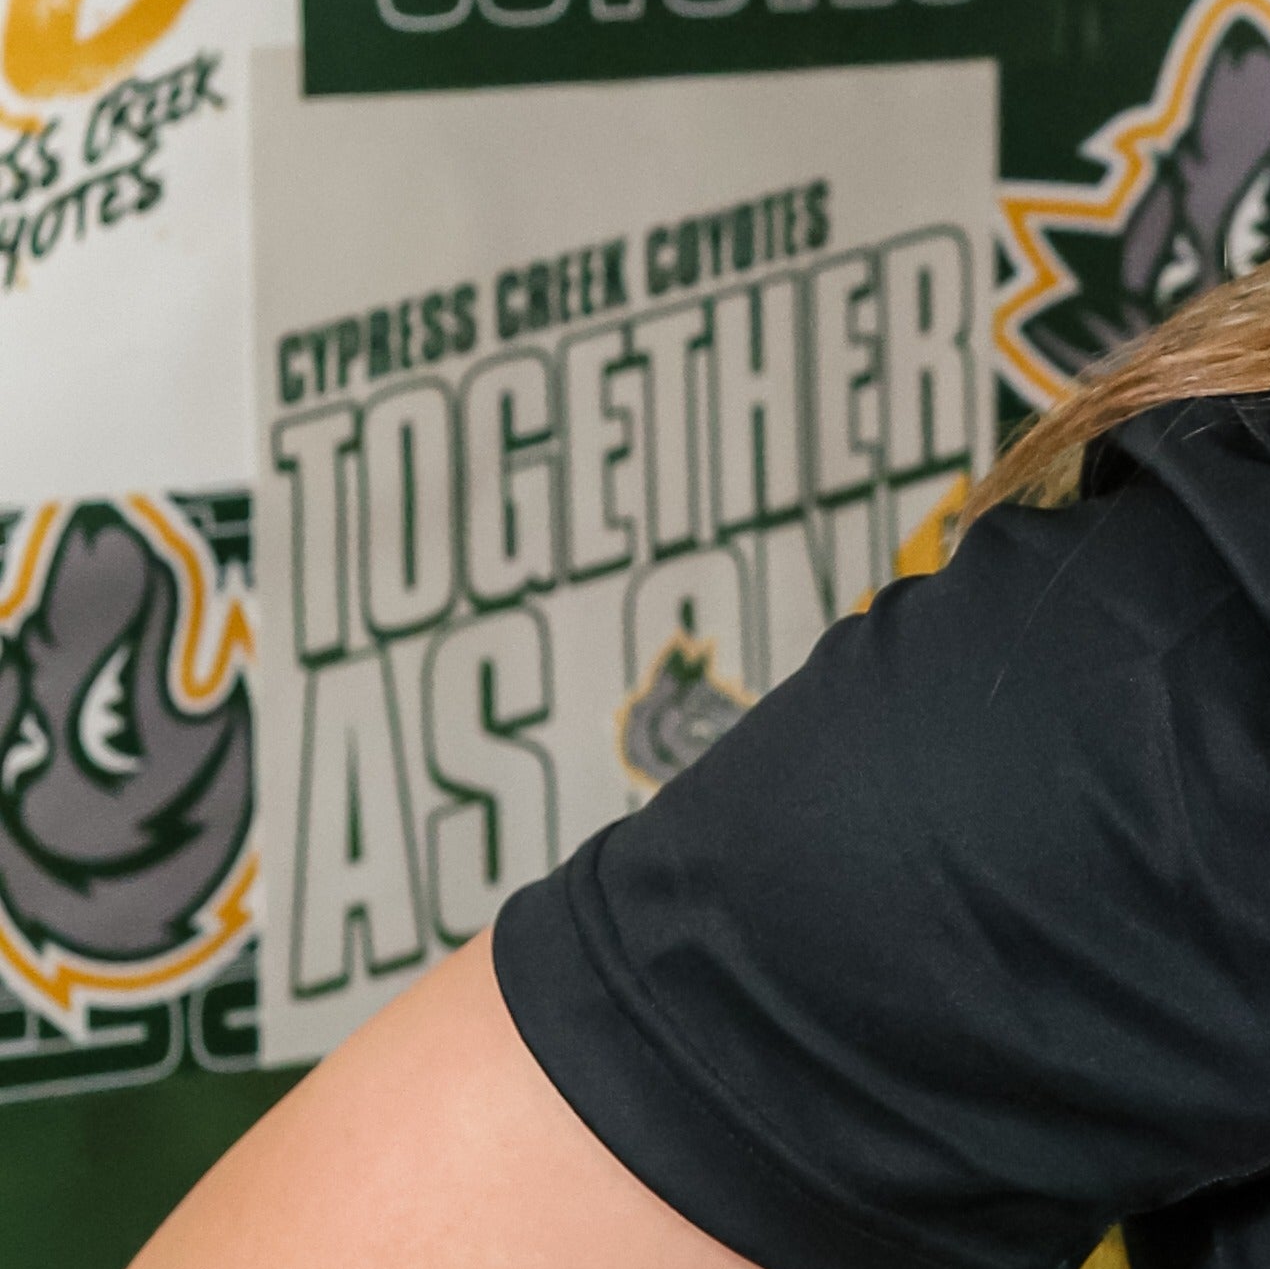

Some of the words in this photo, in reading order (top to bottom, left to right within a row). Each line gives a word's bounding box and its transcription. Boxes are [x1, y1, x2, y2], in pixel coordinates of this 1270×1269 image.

[84, 52, 226, 166] CREEK
[270, 222, 976, 672] TOGETHER
[277, 282, 480, 406] CYPRESS
[495, 235, 630, 342] CREEK
[645, 178, 832, 298] COYOTES
[288, 602, 562, 1004] AS
